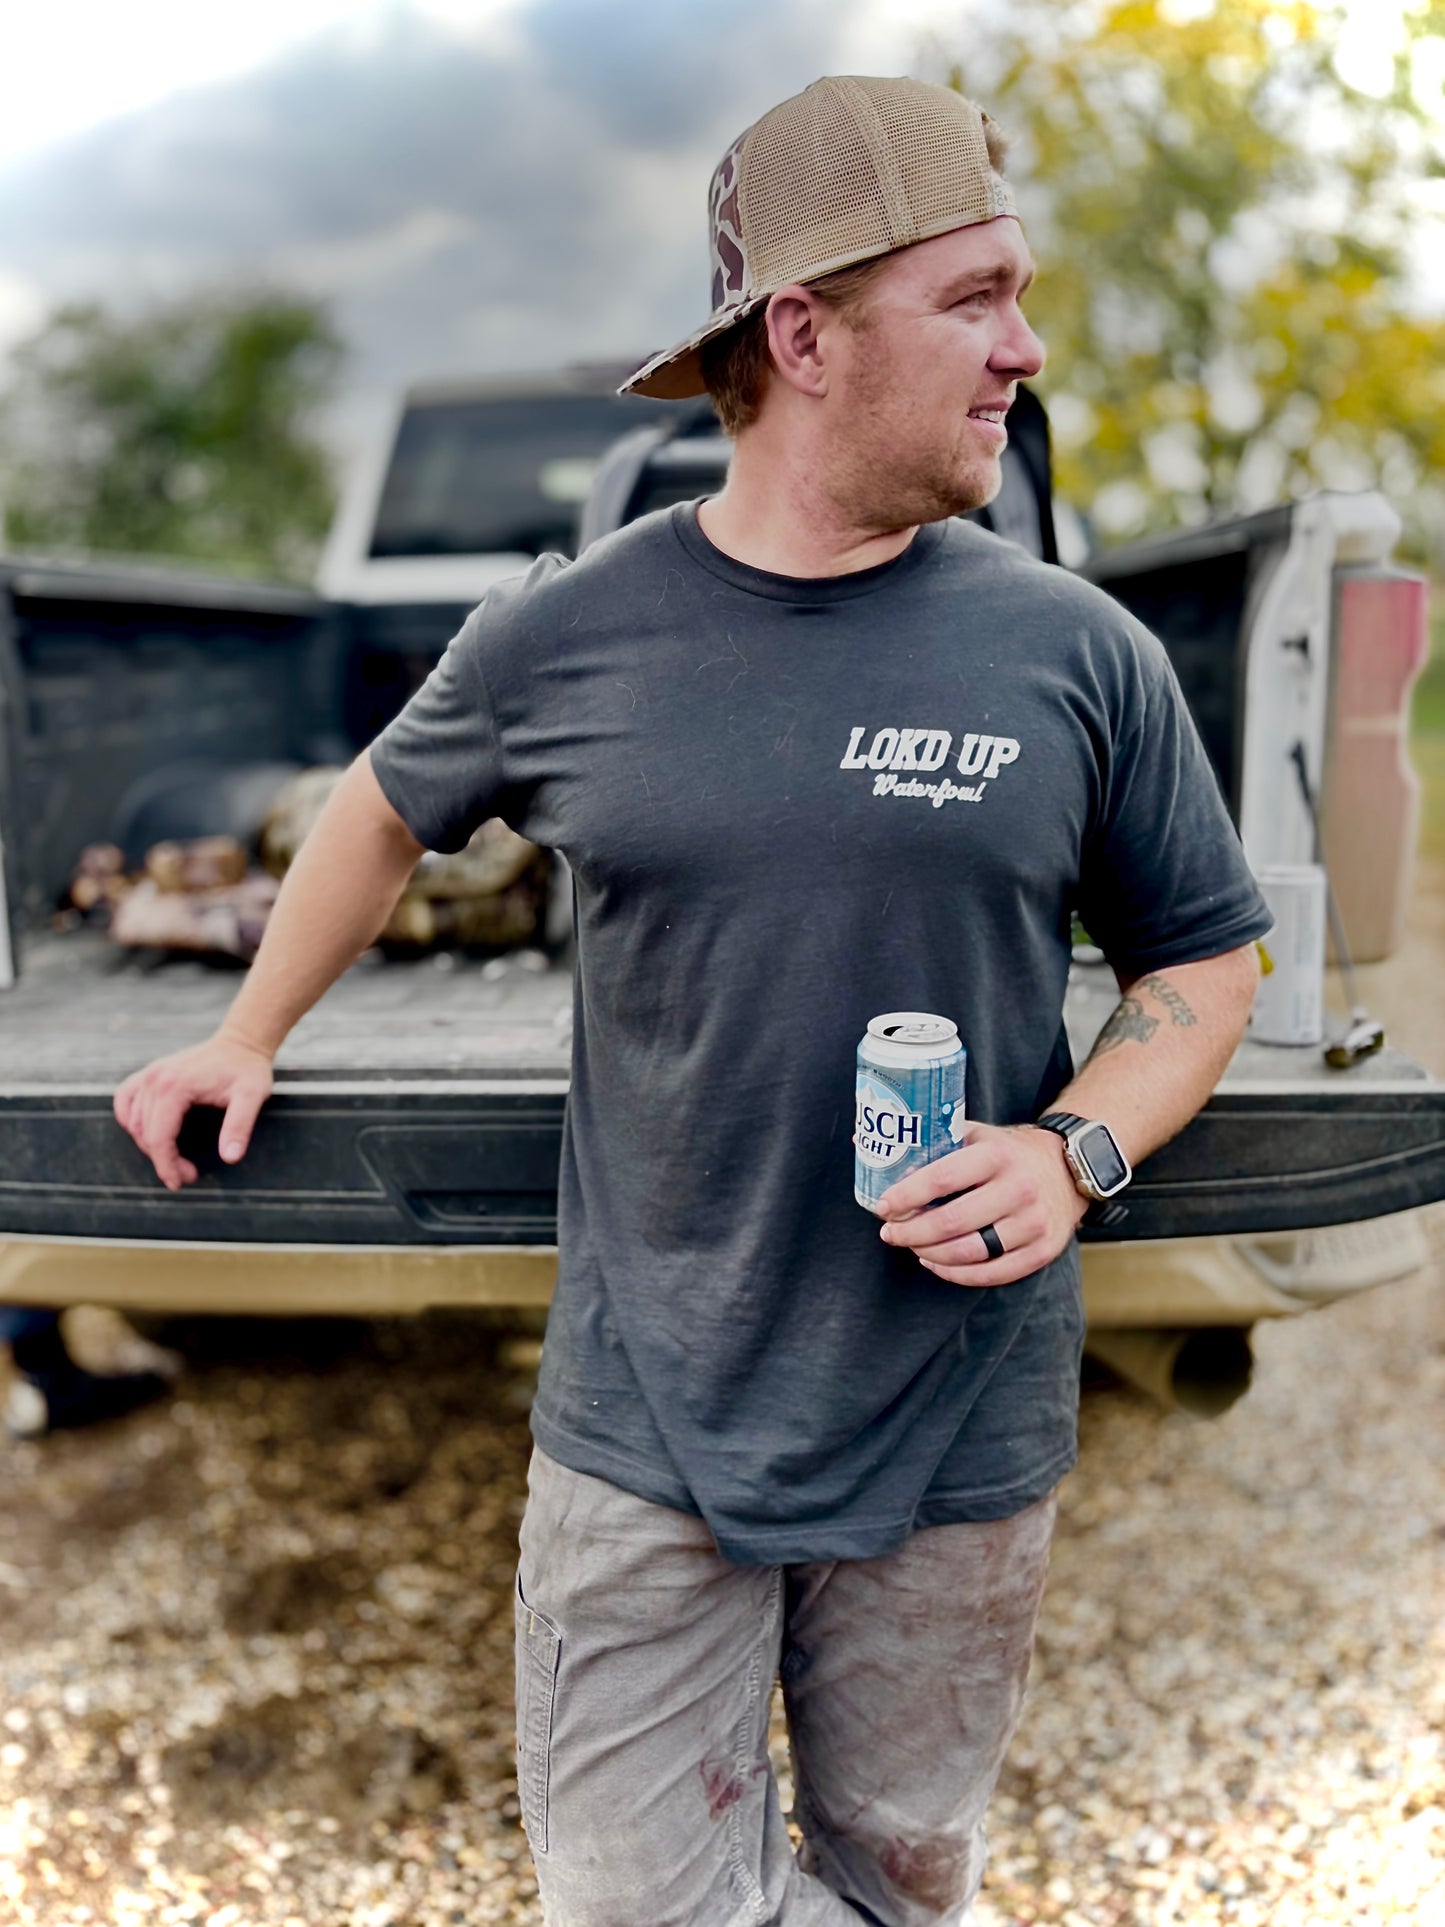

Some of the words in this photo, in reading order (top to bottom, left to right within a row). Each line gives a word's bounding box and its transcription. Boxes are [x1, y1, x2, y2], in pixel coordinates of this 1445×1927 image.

[840, 727, 952, 771] LOKD
[957, 733, 1021, 778] UP
[872, 773, 987, 808] Waterfowl
[858, 1103, 918, 1144] USCH
[858, 1132, 896, 1157] IGHT
